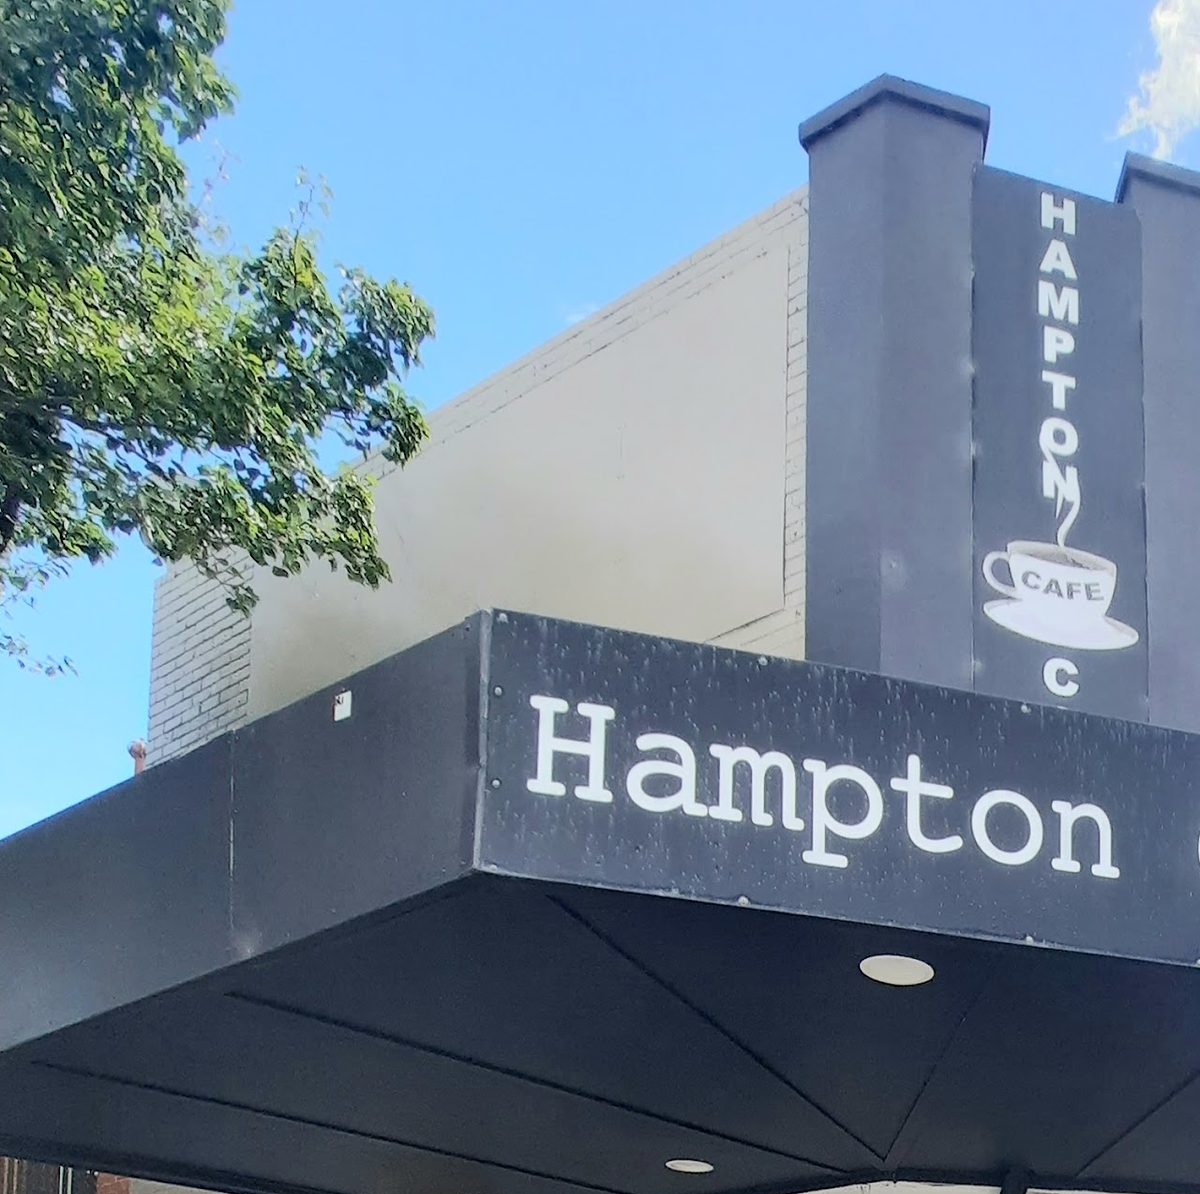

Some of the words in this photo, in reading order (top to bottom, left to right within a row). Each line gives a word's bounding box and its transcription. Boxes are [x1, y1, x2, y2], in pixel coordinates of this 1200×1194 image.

[1038, 192, 1080, 502] HAMPTON
[1021, 571, 1104, 600] CAFE
[526, 694, 1120, 878] Hampton
